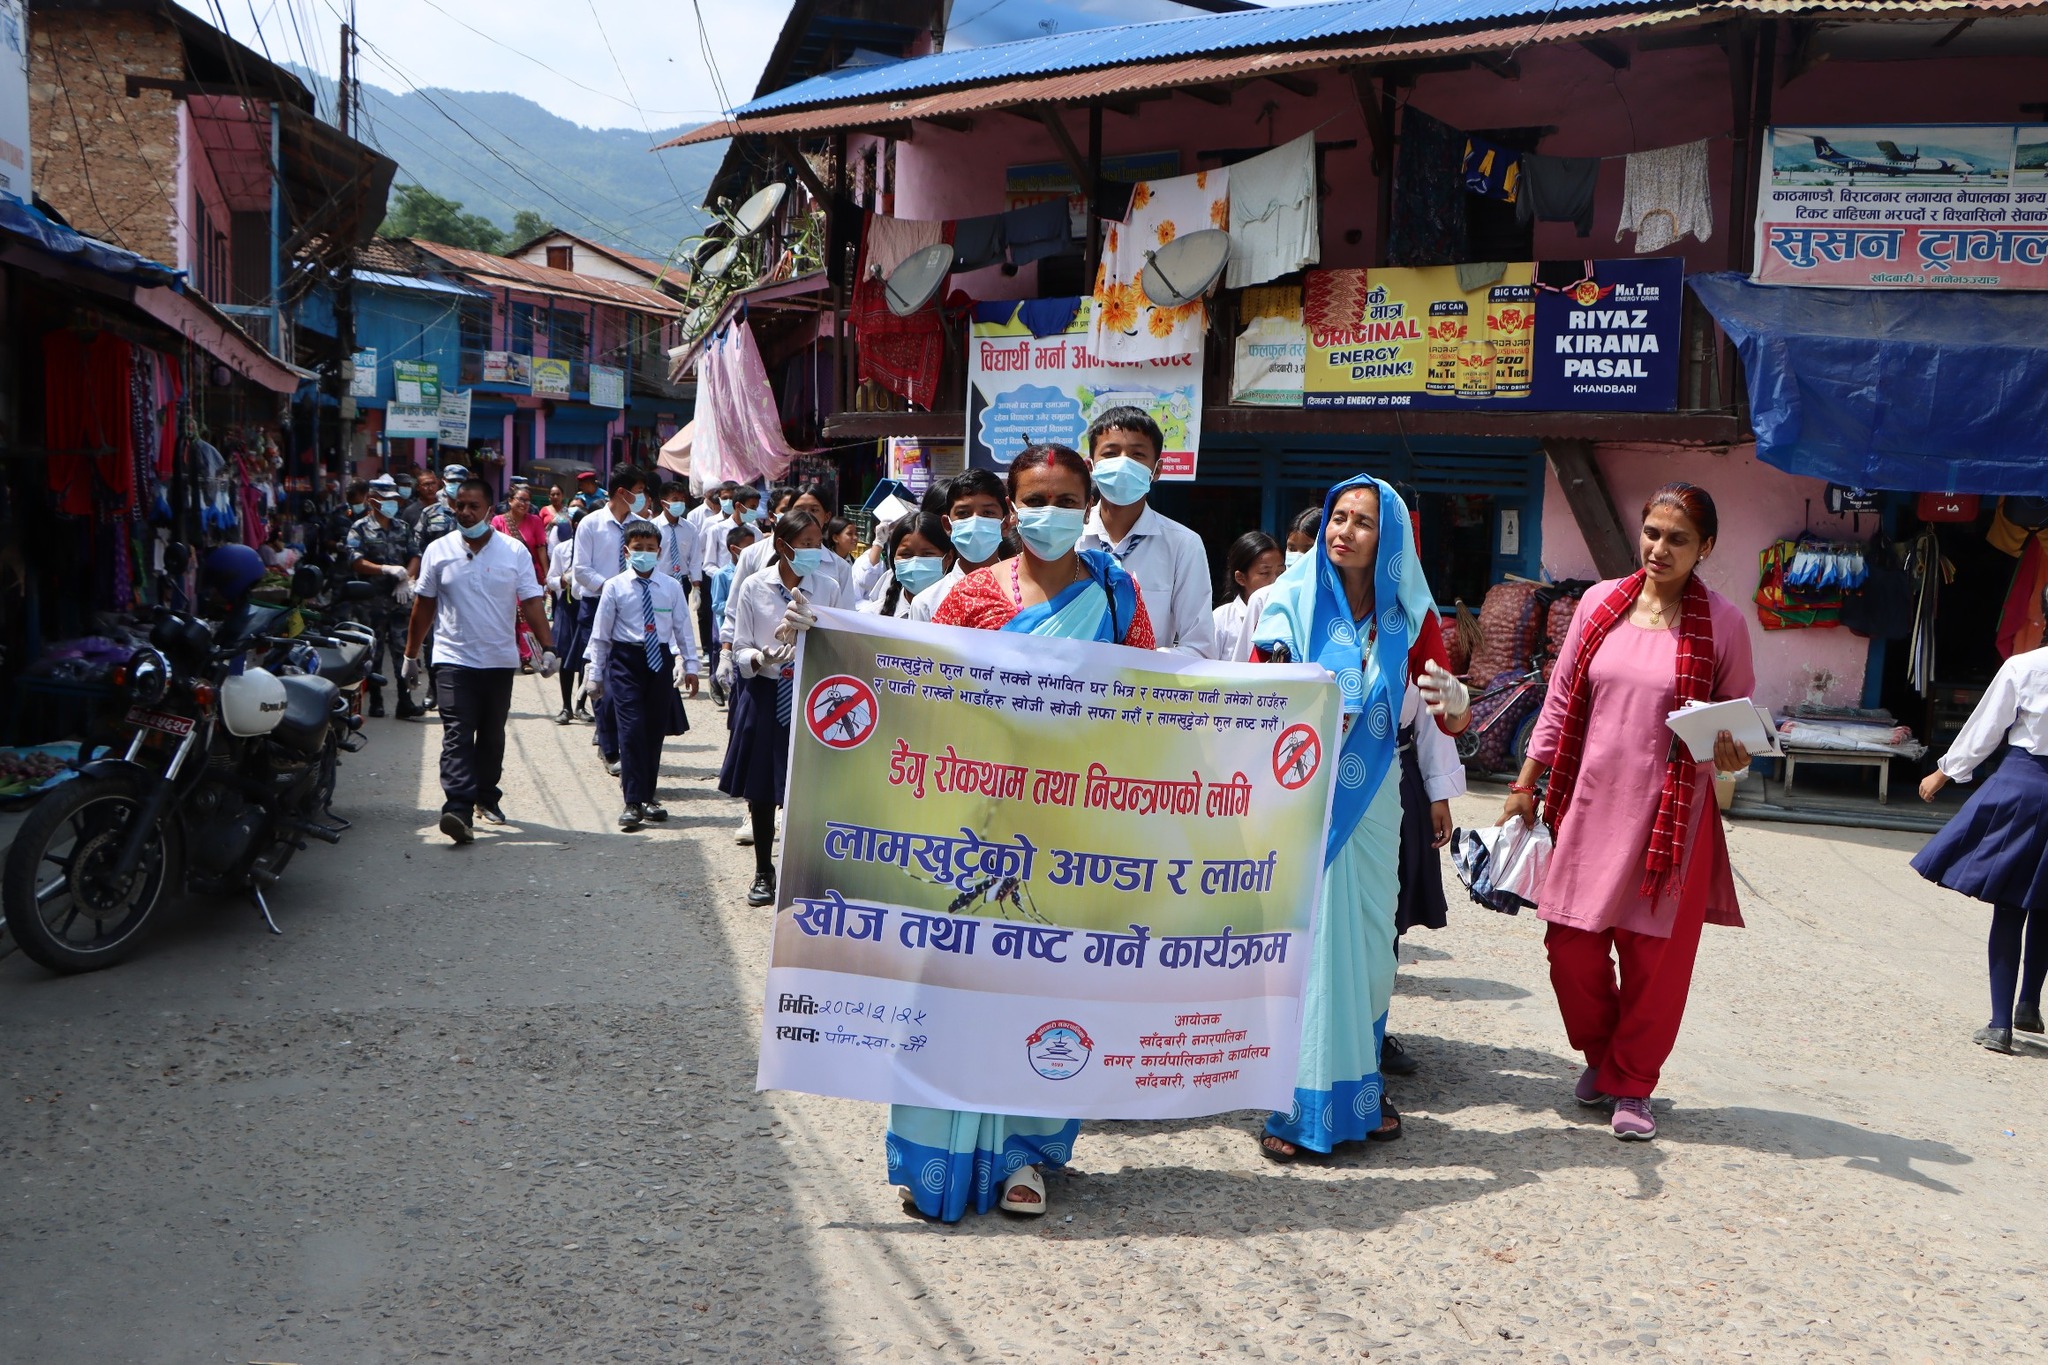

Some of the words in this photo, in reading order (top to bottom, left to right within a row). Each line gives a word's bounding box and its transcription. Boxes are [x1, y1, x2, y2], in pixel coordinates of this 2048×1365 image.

[1839, 189, 1902, 203] विराटनगर
[1905, 192, 1952, 203] लगायत
[1957, 191, 2010, 204] नेपालका
[2014, 192, 2047, 203] अन्य
[1795, 206, 1828, 219] टिकट
[1833, 206, 1881, 221] चाहिएमा
[1885, 207, 1926, 222] भरपर्दो
[1930, 209, 1938, 221] र
[1943, 207, 2006, 222] विश्वासिलो
[1771, 228, 1904, 268] सुसन
[1494, 288, 1510, 297] BIG
[1511, 288, 1530, 297] CAN
[1370, 303, 1404, 319] मात्र
[1433, 303, 1446, 311] BIG
[1448, 303, 1464, 311] CAN
[1568, 310, 1649, 329] RIYAZ
[1312, 319, 1421, 348] ORIGINAL
[1555, 334, 1660, 354] KIRANA
[980, 340, 1030, 372] विद्यार्थी
[1034, 340, 1067, 370] भर्ना
[1329, 346, 1400, 365] ENERGY
[1352, 361, 1413, 379] DRINK!
[1564, 359, 1649, 378] PASAL
[1573, 384, 1637, 394] KHANDBARI
[1346, 396, 1377, 405] ENERGY
[1390, 396, 1411, 405] DOSE
[876, 653, 935, 677] लामखुट्टेले
[939, 662, 965, 681] फुल
[969, 665, 995, 682] पार्न
[999, 670, 1033, 687] सक्ने
[1038, 674, 1085, 694] संभावित
[1090, 681, 1109, 698] घर
[1113, 680, 1136, 698] भित्र
[1139, 686, 1149, 701] र
[1152, 687, 1195, 704] वरपरका
[1197, 688, 1221, 704] पानी
[1223, 691, 1254, 706] जमेको
[873, 678, 883, 694] र
[887, 678, 917, 696] पानी
[921, 684, 955, 702] राख्ने
[1011, 695, 1045, 713] खोजी
[1049, 700, 1083, 717] खोजी
[1088, 704, 1117, 721] सफा
[1146, 711, 1155, 726] र
[1157, 711, 1210, 732] लामखुट्टेको
[1213, 718, 1232, 733] फुल
[1235, 716, 1258, 731] नष्ट
[933, 745, 1029, 803] रोकथाम
[1031, 766, 1081, 807] तथा
[1083, 762, 1202, 818] नियन्त्रणको
[1204, 771, 1253, 818] लागि
[824, 820, 1040, 892] लामखुट्टेको
[1047, 847, 1159, 893] अण्डा
[1166, 858, 1196, 895] र
[1199, 849, 1277, 894] लार्भा
[792, 892, 888, 942] खोज
[898, 911, 981, 957] तथा
[991, 920, 1075, 963] नष्ट
[1082, 923, 1152, 970] गर्ने
[1158, 925, 1293, 970] कार्यक्रम
[1174, 1011, 1223, 1027] आयोजक
[1139, 1032, 1188, 1049] खाँदबारी
[1191, 1029, 1248, 1047] नगरपालिका
[1103, 1054, 1136, 1069] नगर
[1141, 1048, 1225, 1068] कार्यपालिकाको
[1227, 1044, 1271, 1061] कार्यालय
[1192, 1069, 1240, 1089] संखुवासभा
